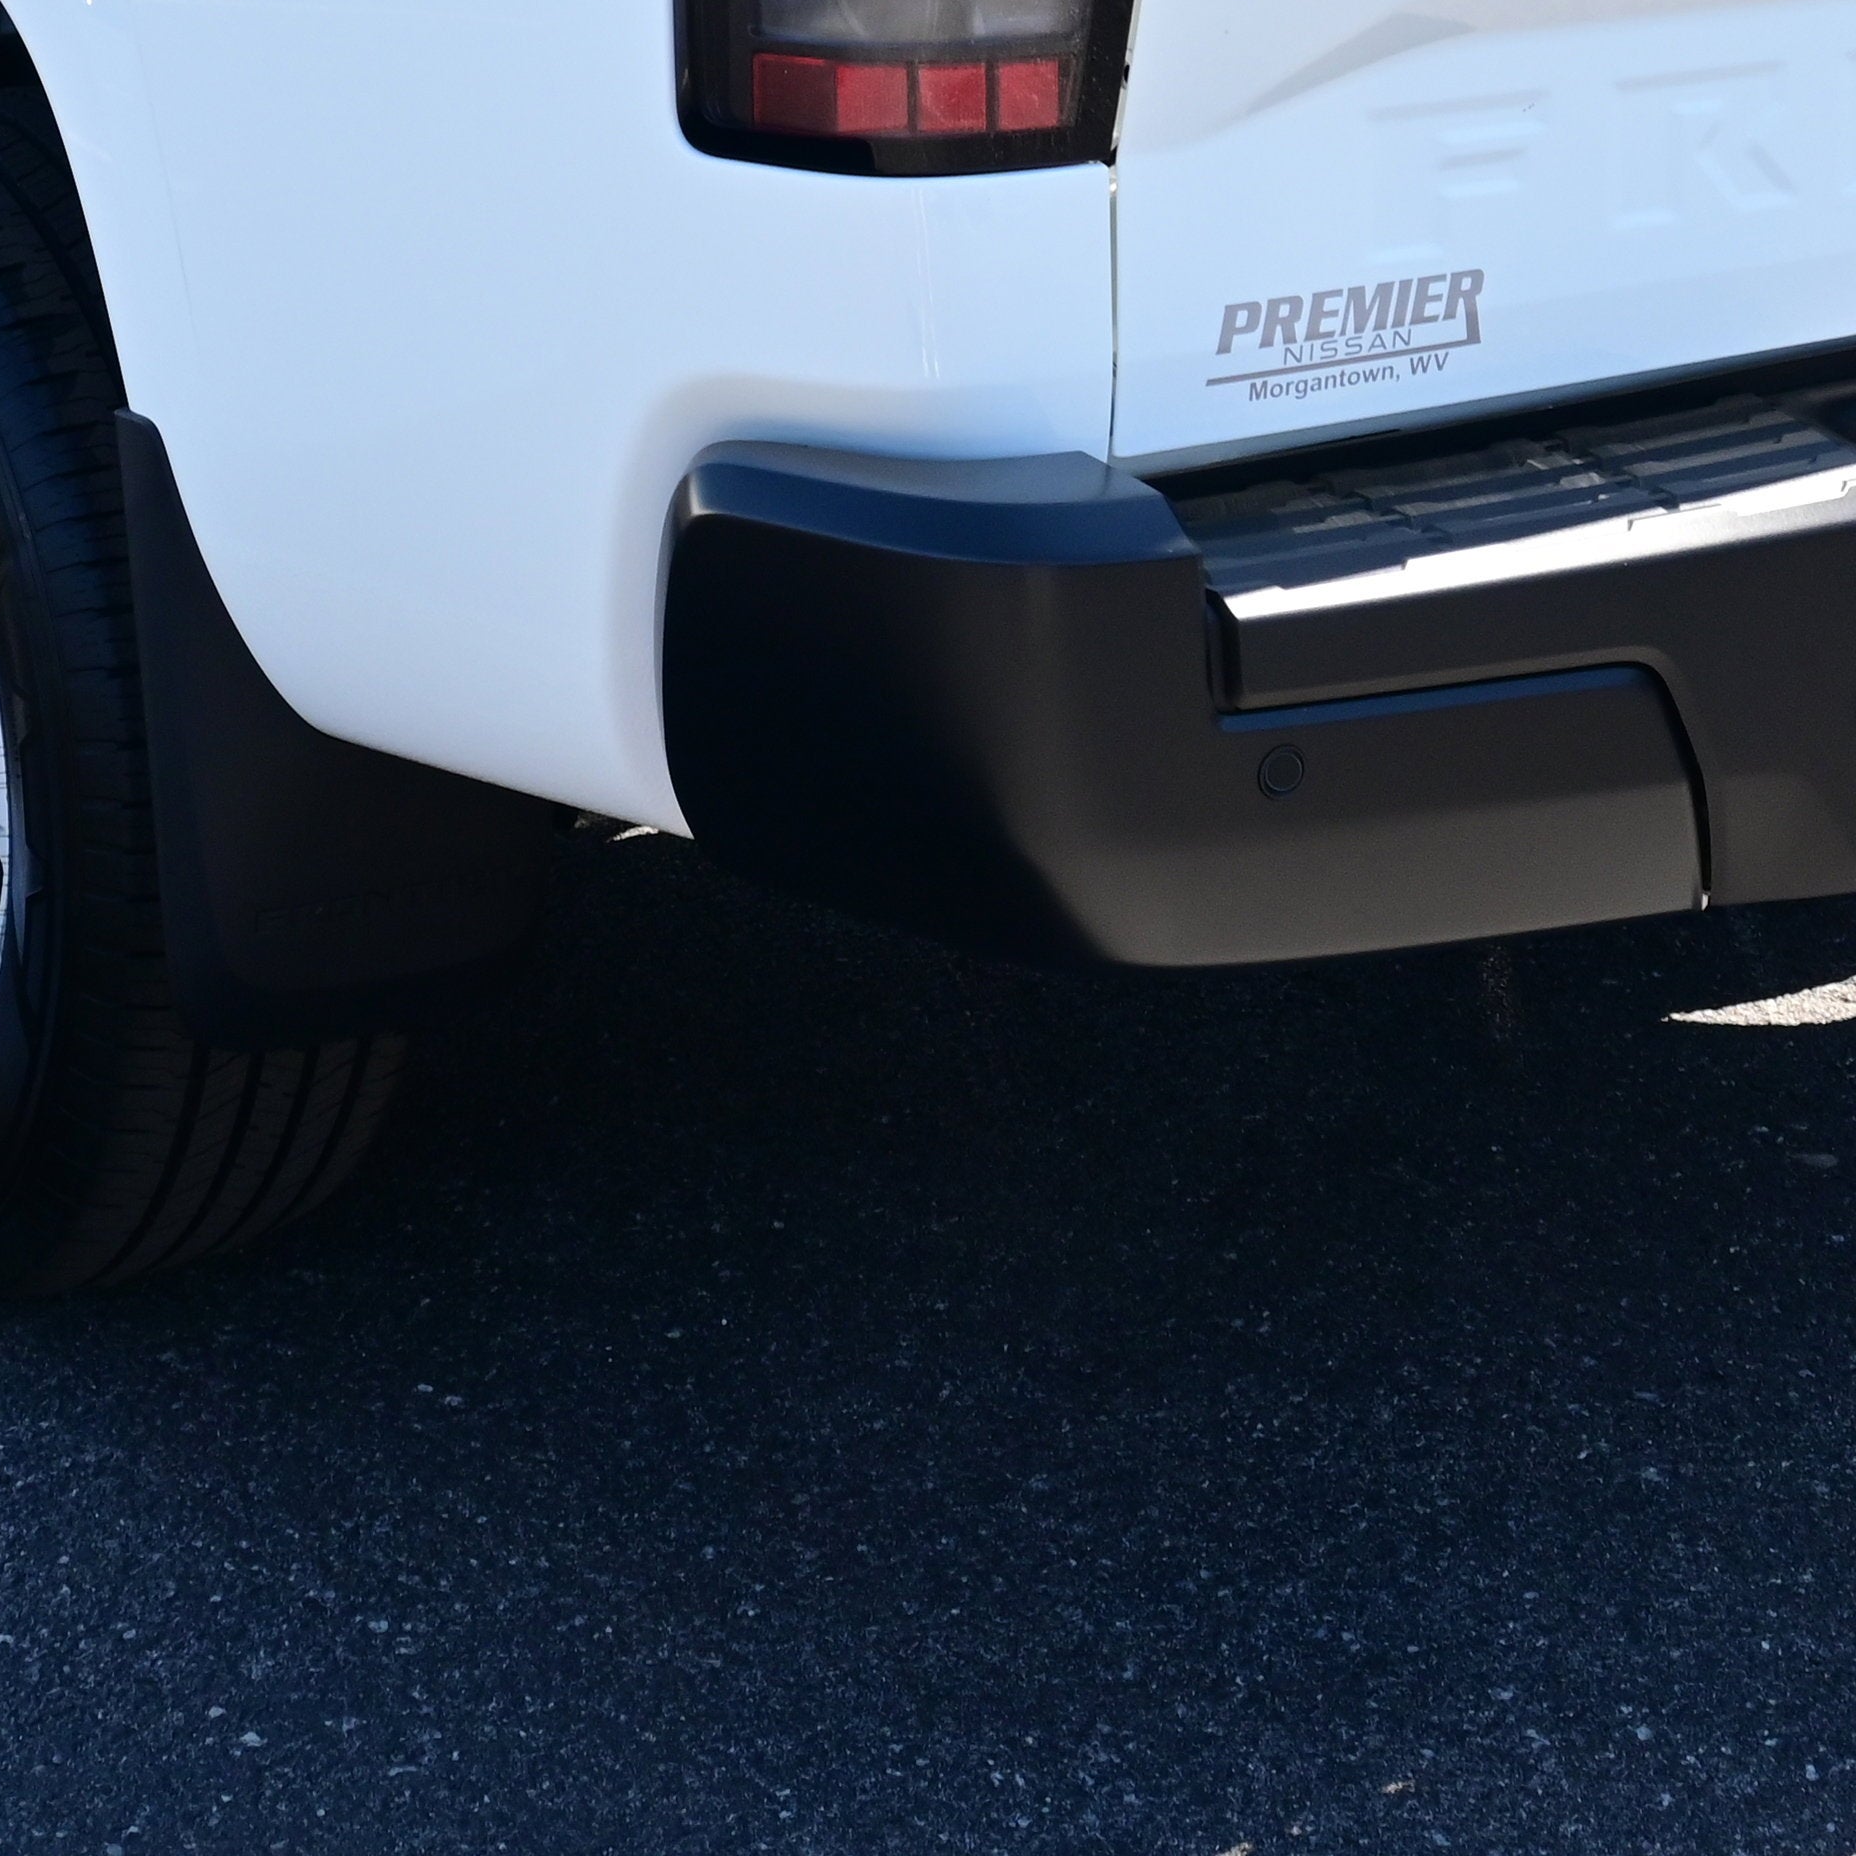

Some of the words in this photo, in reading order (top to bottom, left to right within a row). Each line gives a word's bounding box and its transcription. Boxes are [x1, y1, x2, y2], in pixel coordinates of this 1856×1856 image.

[1215, 268, 1485, 356] PREMIER
[1283, 328, 1413, 366] NISSAN
[1248, 363, 1401, 402] Morgantown,
[1410, 351, 1449, 376] WV
